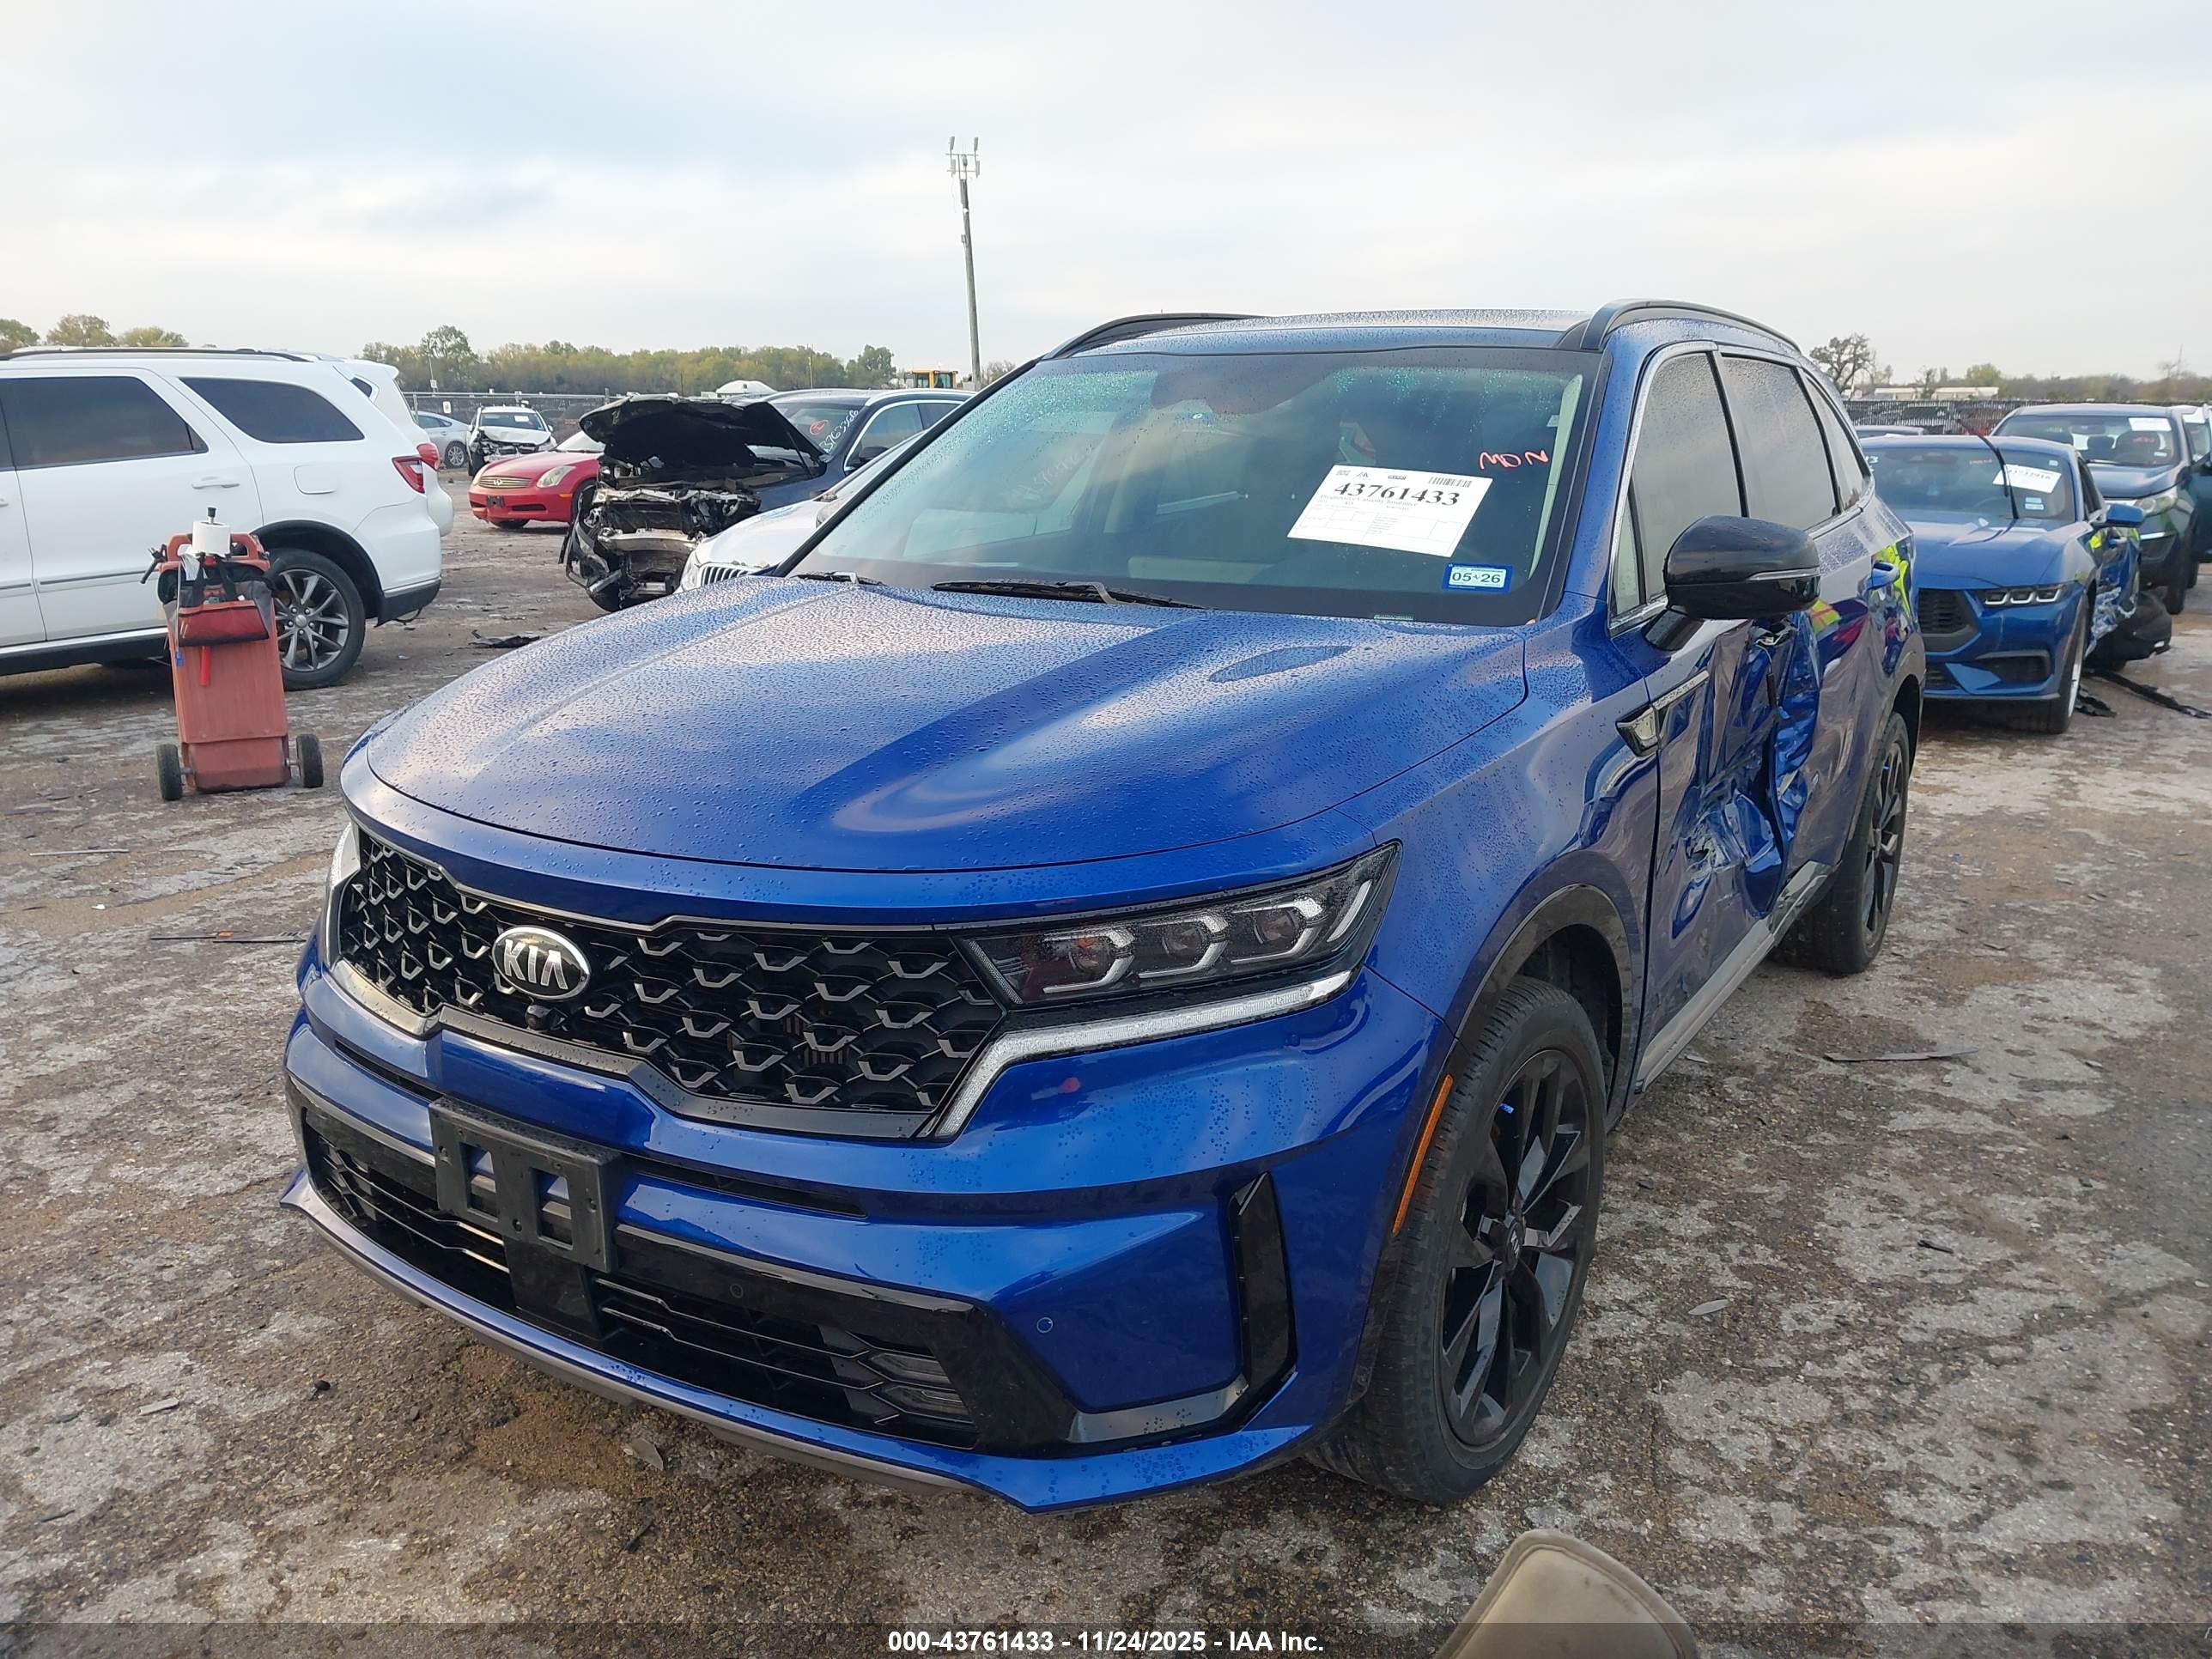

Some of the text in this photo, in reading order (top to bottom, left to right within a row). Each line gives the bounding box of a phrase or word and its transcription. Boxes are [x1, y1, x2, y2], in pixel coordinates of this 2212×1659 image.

[1334, 483, 1460, 506] 43761433
[1452, 572, 1501, 584] 05 26
[504, 939, 568, 990] KIA
